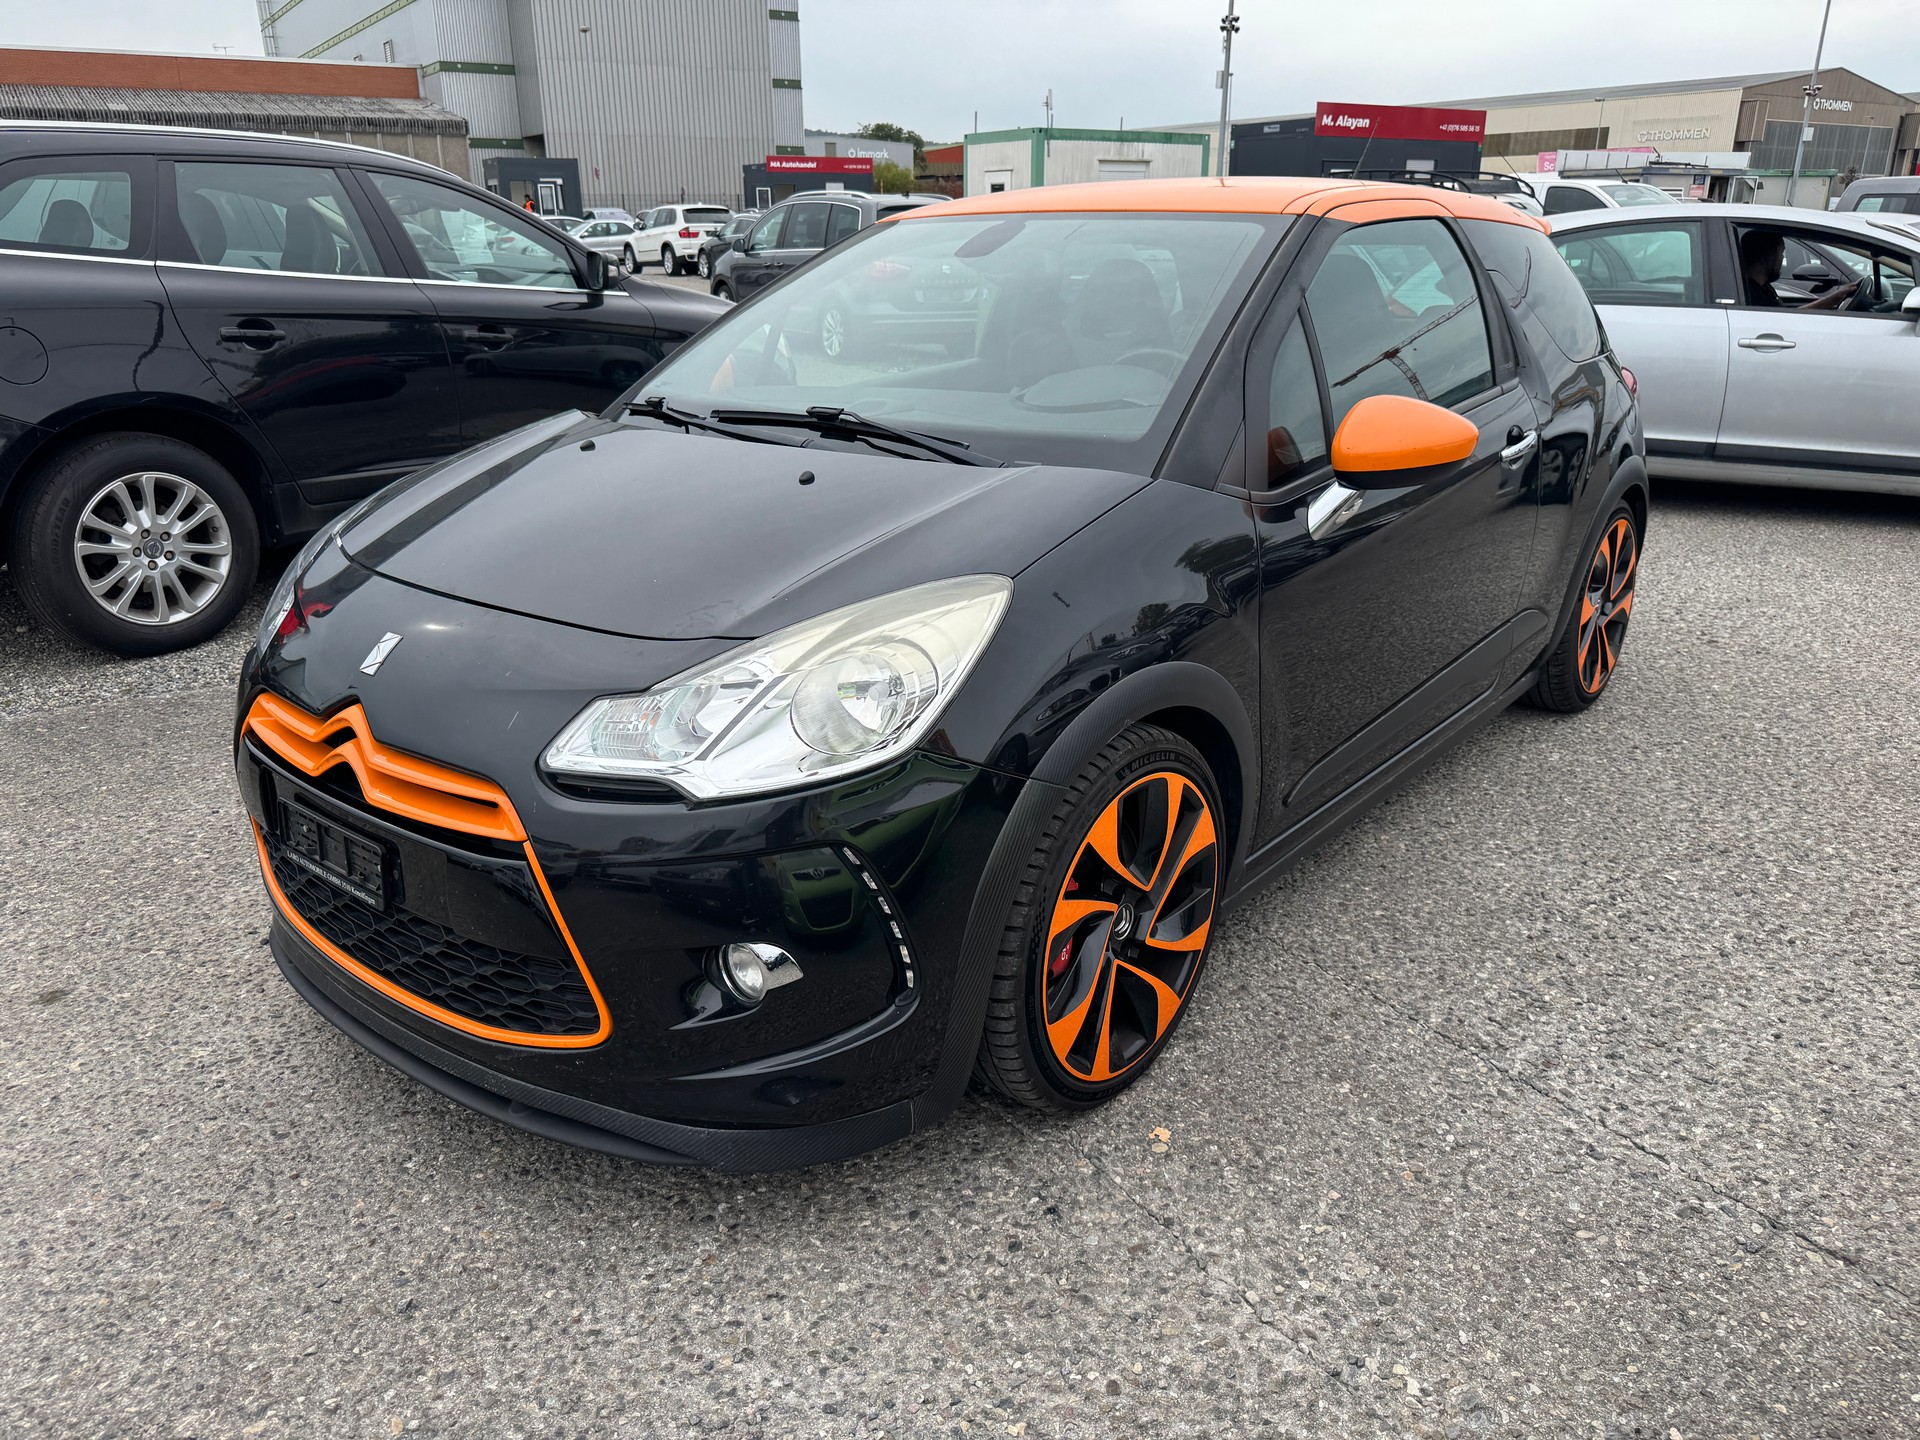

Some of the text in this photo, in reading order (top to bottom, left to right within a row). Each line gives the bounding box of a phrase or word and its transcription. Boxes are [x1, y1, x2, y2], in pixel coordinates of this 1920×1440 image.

[1820, 99, 1853, 112] THOMMEN
[1321, 114, 1370, 130] M. Alayan
[1649, 128, 1710, 141] THOMMEN
[781, 161, 817, 169] Autohandel
[1131, 752, 1176, 771] MICHELIN
